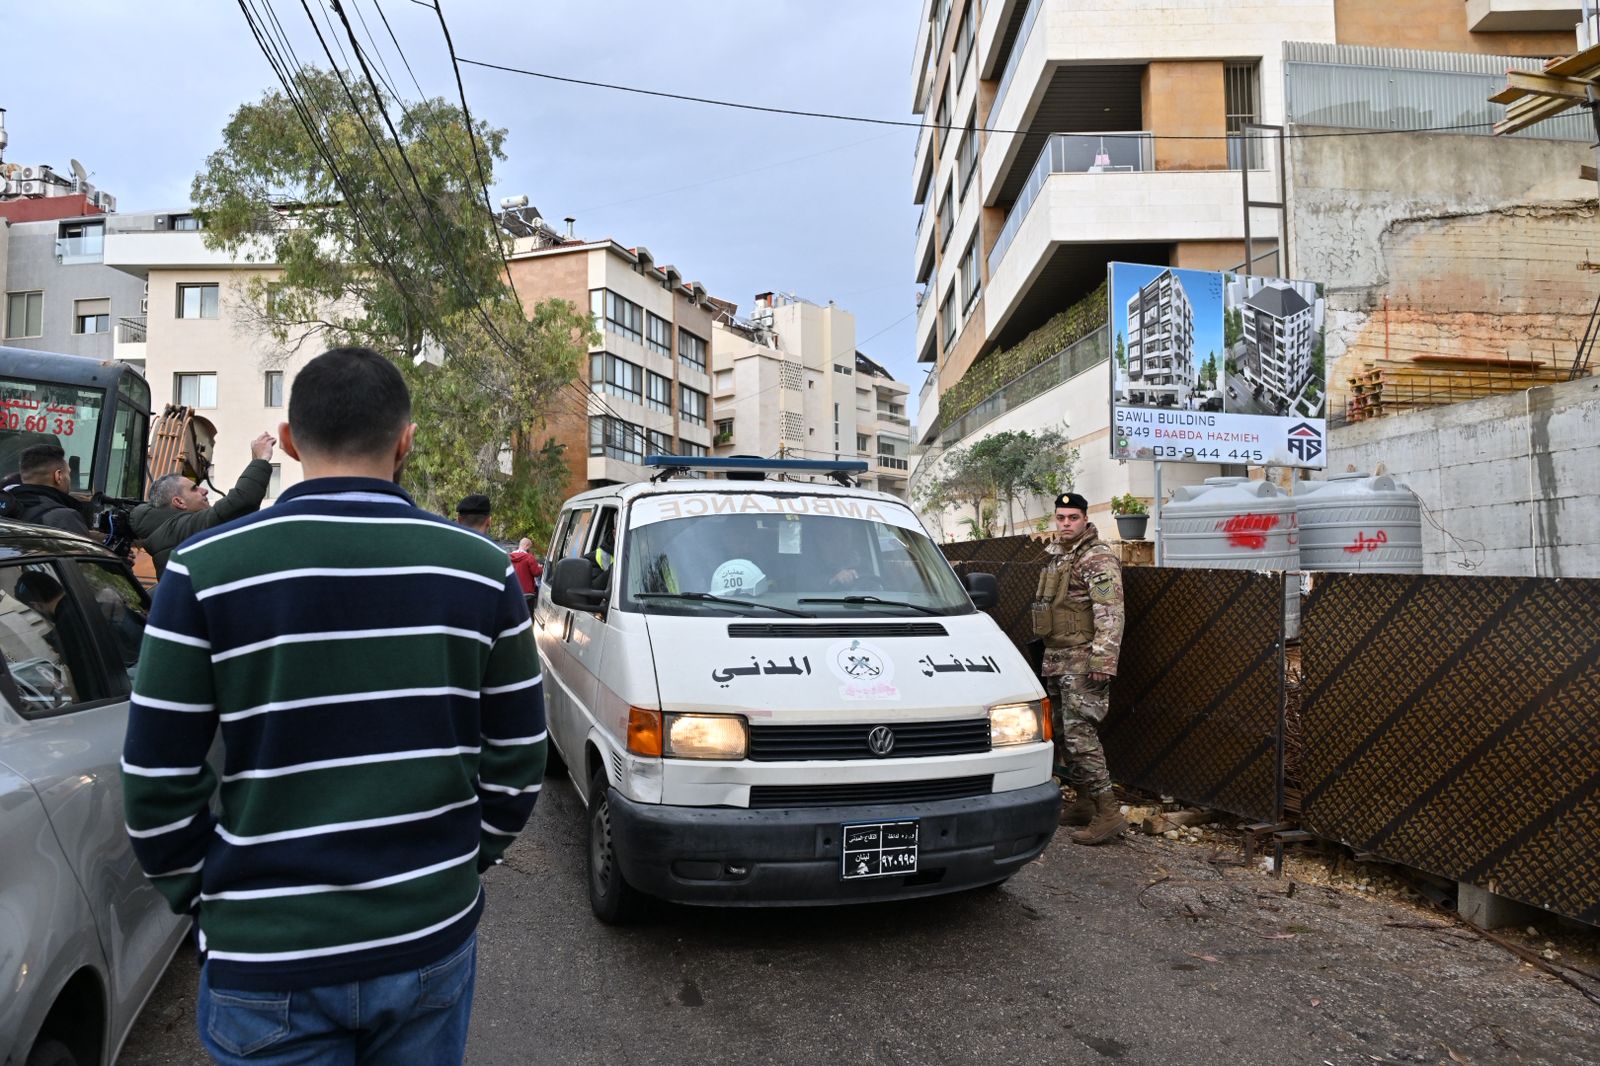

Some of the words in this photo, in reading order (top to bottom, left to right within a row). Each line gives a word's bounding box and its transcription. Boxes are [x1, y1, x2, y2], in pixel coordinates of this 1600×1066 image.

[26, 415, 47, 432] 60
[52, 418, 74, 436] 33
[1116, 410, 1152, 424] SAWLI
[1158, 414, 1216, 426] BUILDING
[1117, 426, 1150, 437] 5349
[1155, 428, 1202, 440] BAABDA
[1208, 432, 1259, 443] HAZMIEH
[1153, 446, 1220, 458] 03-944
[1228, 448, 1263, 461] 445
[724, 577, 743, 588] 200
[712, 655, 812, 688] المدني
